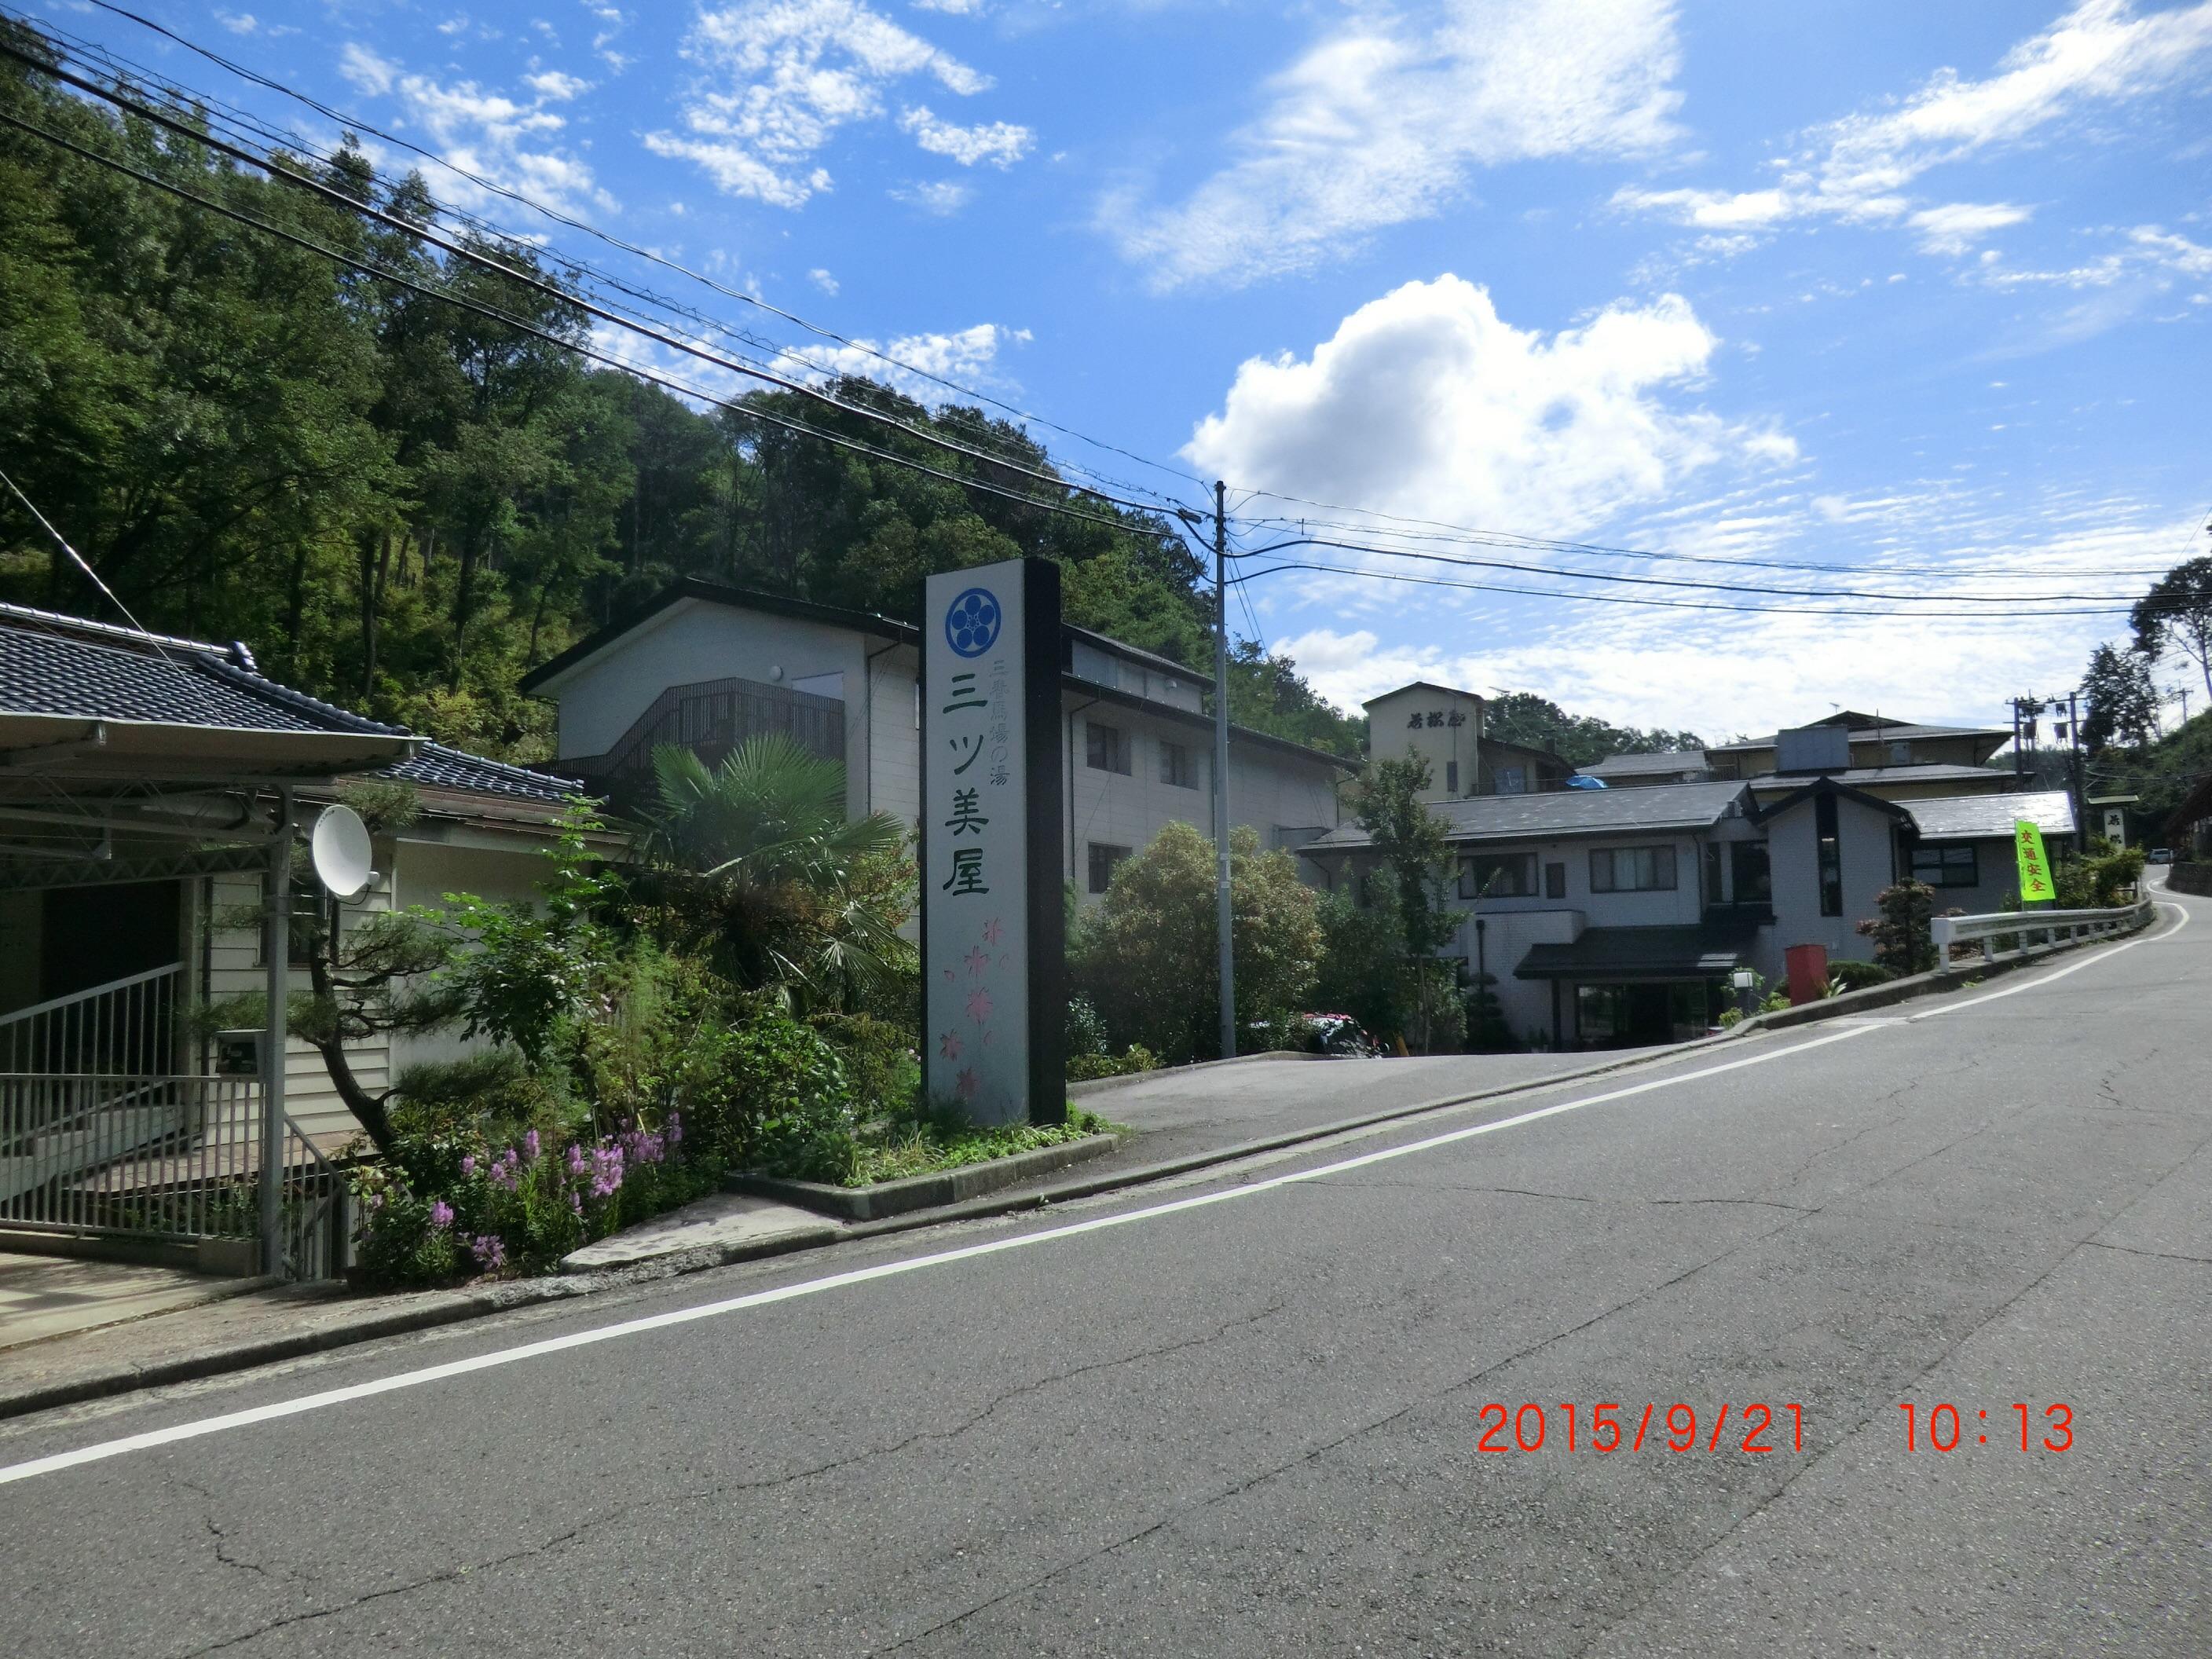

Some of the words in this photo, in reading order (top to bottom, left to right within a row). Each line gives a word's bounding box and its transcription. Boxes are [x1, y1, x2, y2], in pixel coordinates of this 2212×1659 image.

[943, 673, 990, 897] 三ツ美屋
[2021, 830, 2046, 892] 交通安全
